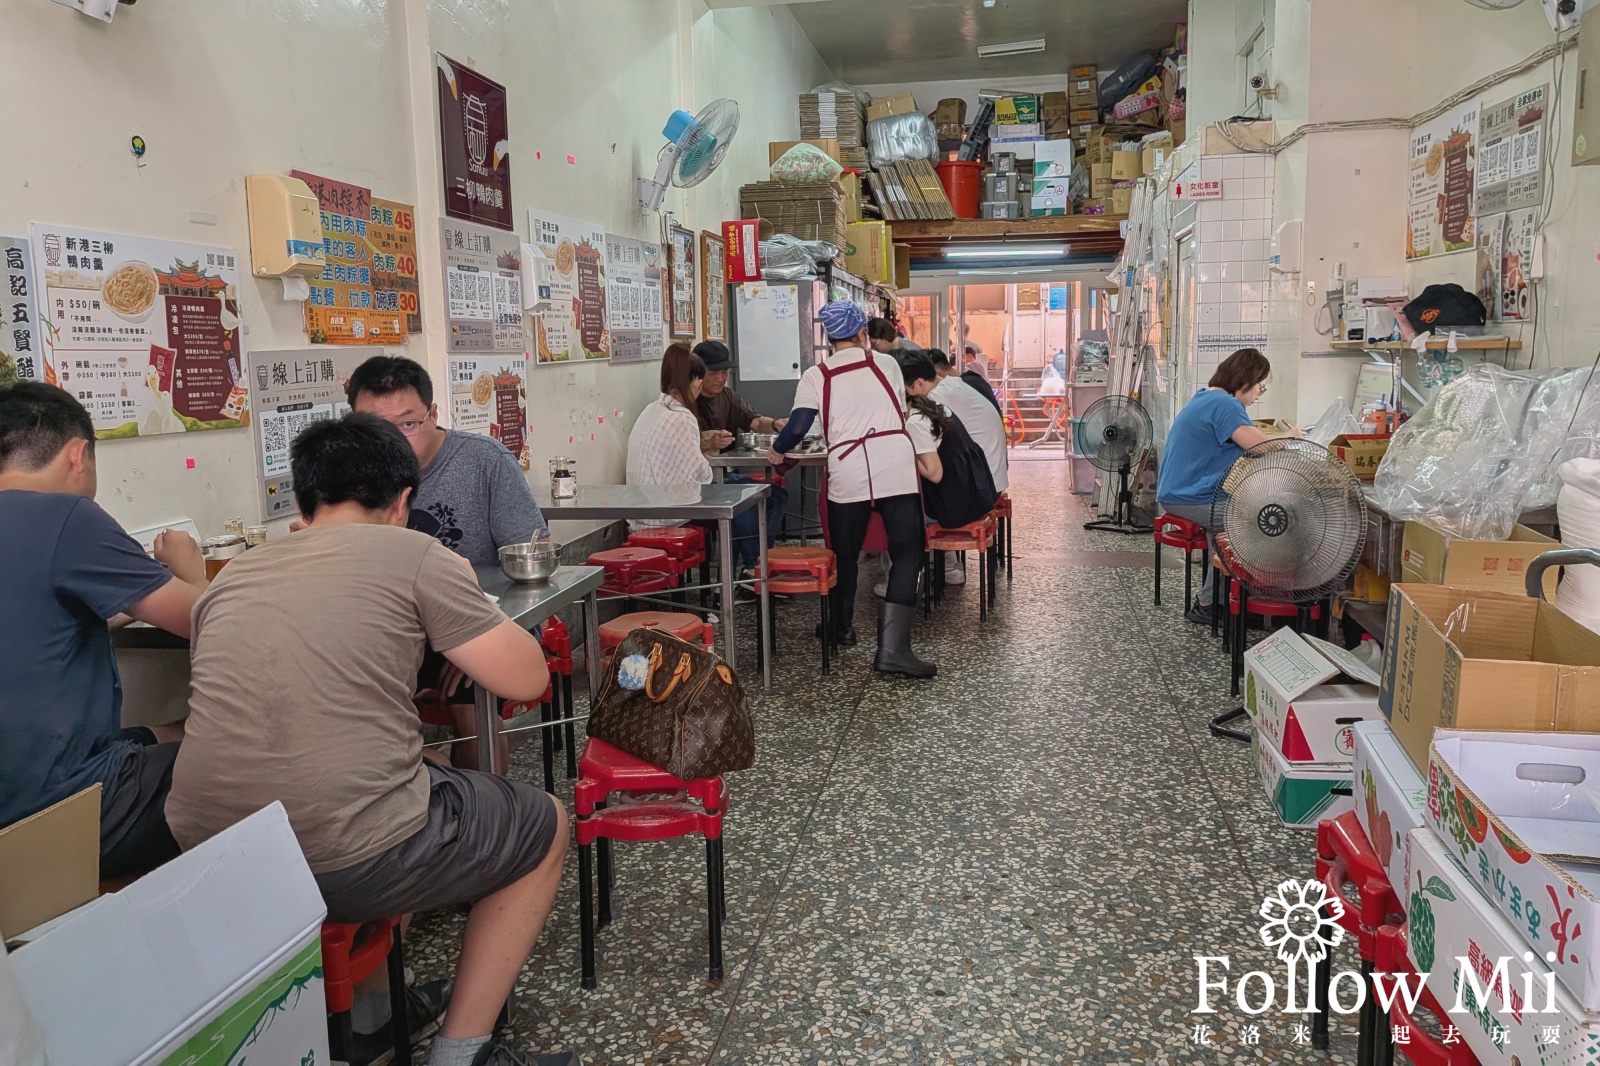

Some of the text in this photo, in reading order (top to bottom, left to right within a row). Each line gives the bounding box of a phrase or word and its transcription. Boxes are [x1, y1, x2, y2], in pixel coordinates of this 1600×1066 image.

[456, 176, 504, 209] 三柳鴨肉羹
[371, 206, 412, 231] 肉粽 45
[66, 237, 114, 255] 新港三柳
[454, 230, 492, 254] 線上訂購
[67, 255, 103, 271] 鴨肉羹
[314, 263, 370, 285] 至肉粽攤
[374, 253, 414, 275] 肉粽 40
[5, 247, 35, 378] 高記五賢醋
[70, 299, 100, 310] $50/碗
[376, 292, 416, 311] 碗粿 30
[76, 360, 90, 369] 碗裝
[272, 359, 335, 386] 線上訂購
[79, 391, 93, 399] 袋裝
[1478, 847, 1541, 940] あまかき
